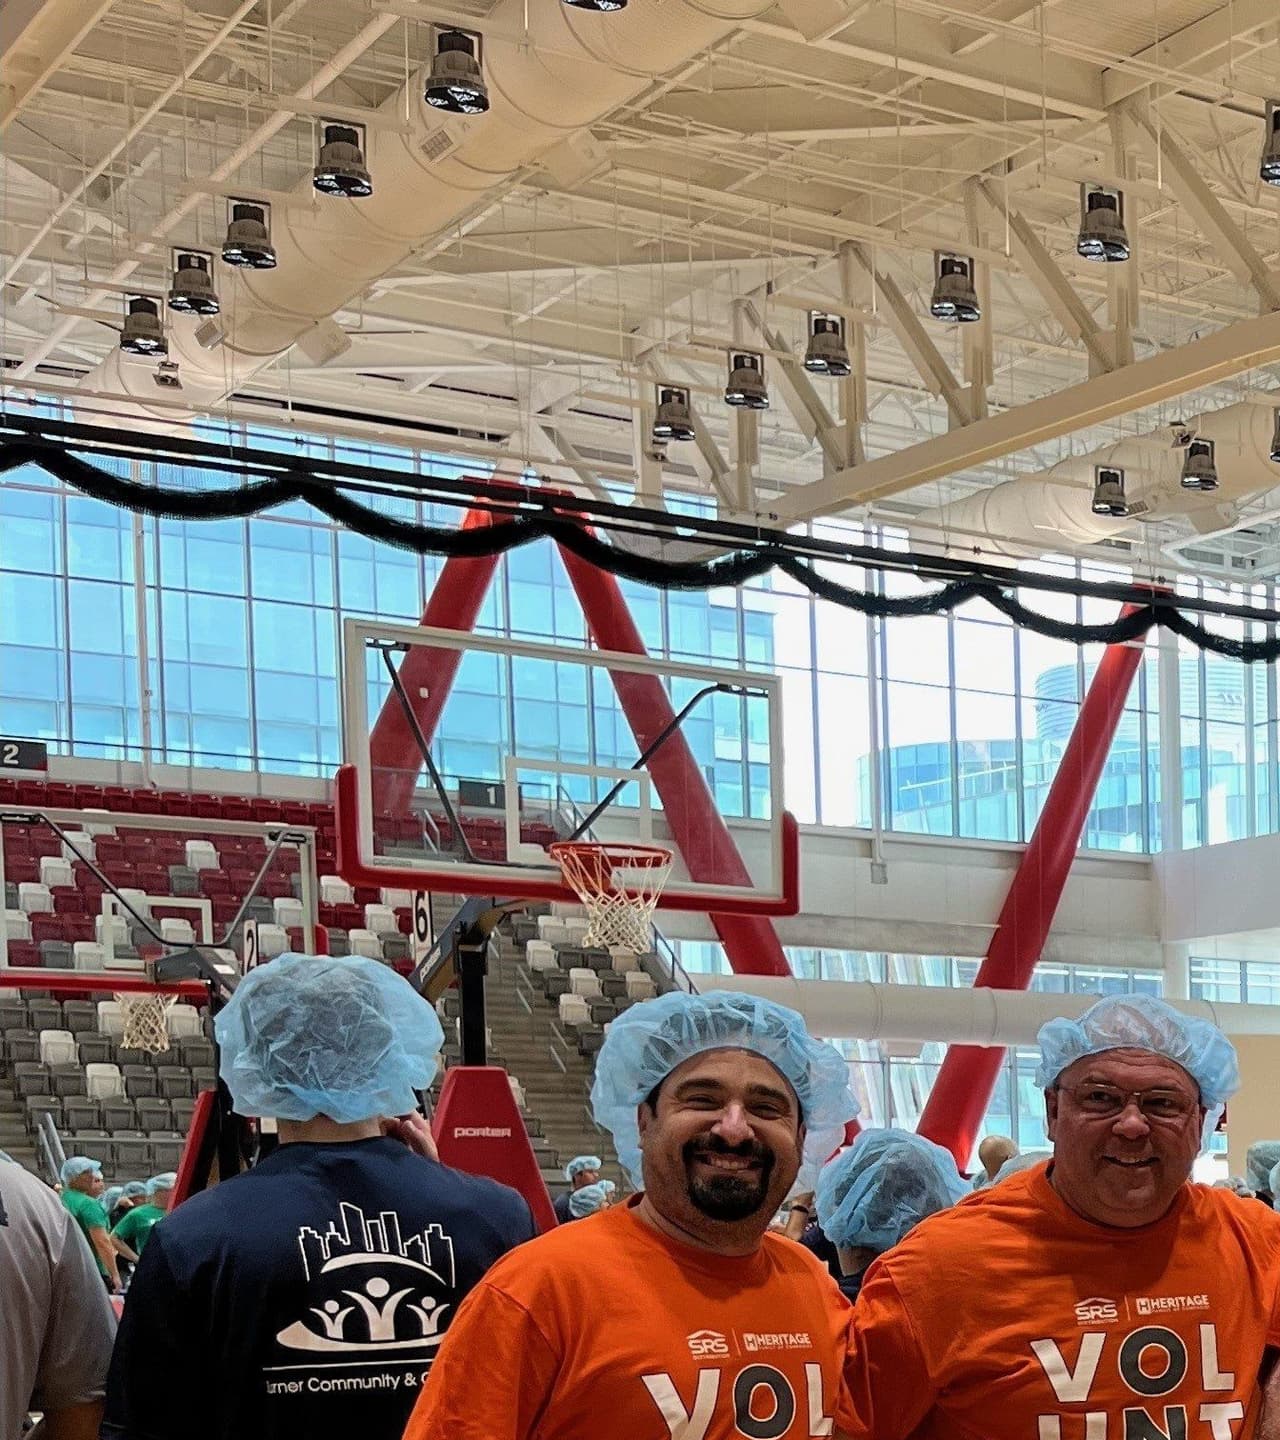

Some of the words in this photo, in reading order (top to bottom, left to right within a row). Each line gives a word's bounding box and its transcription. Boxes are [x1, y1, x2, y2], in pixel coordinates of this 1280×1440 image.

[3, 743, 19, 765] 2
[486, 787, 497, 805] 1
[1074, 1303, 1118, 1321] SRS
[1151, 1294, 1210, 1310] HERITAGE
[687, 1338, 729, 1354] SRS
[756, 1332, 811, 1347] HERITAGE
[1030, 1323, 1235, 1403] VOL
[308, 1373, 400, 1393] Community
[404, 1372, 417, 1386] &
